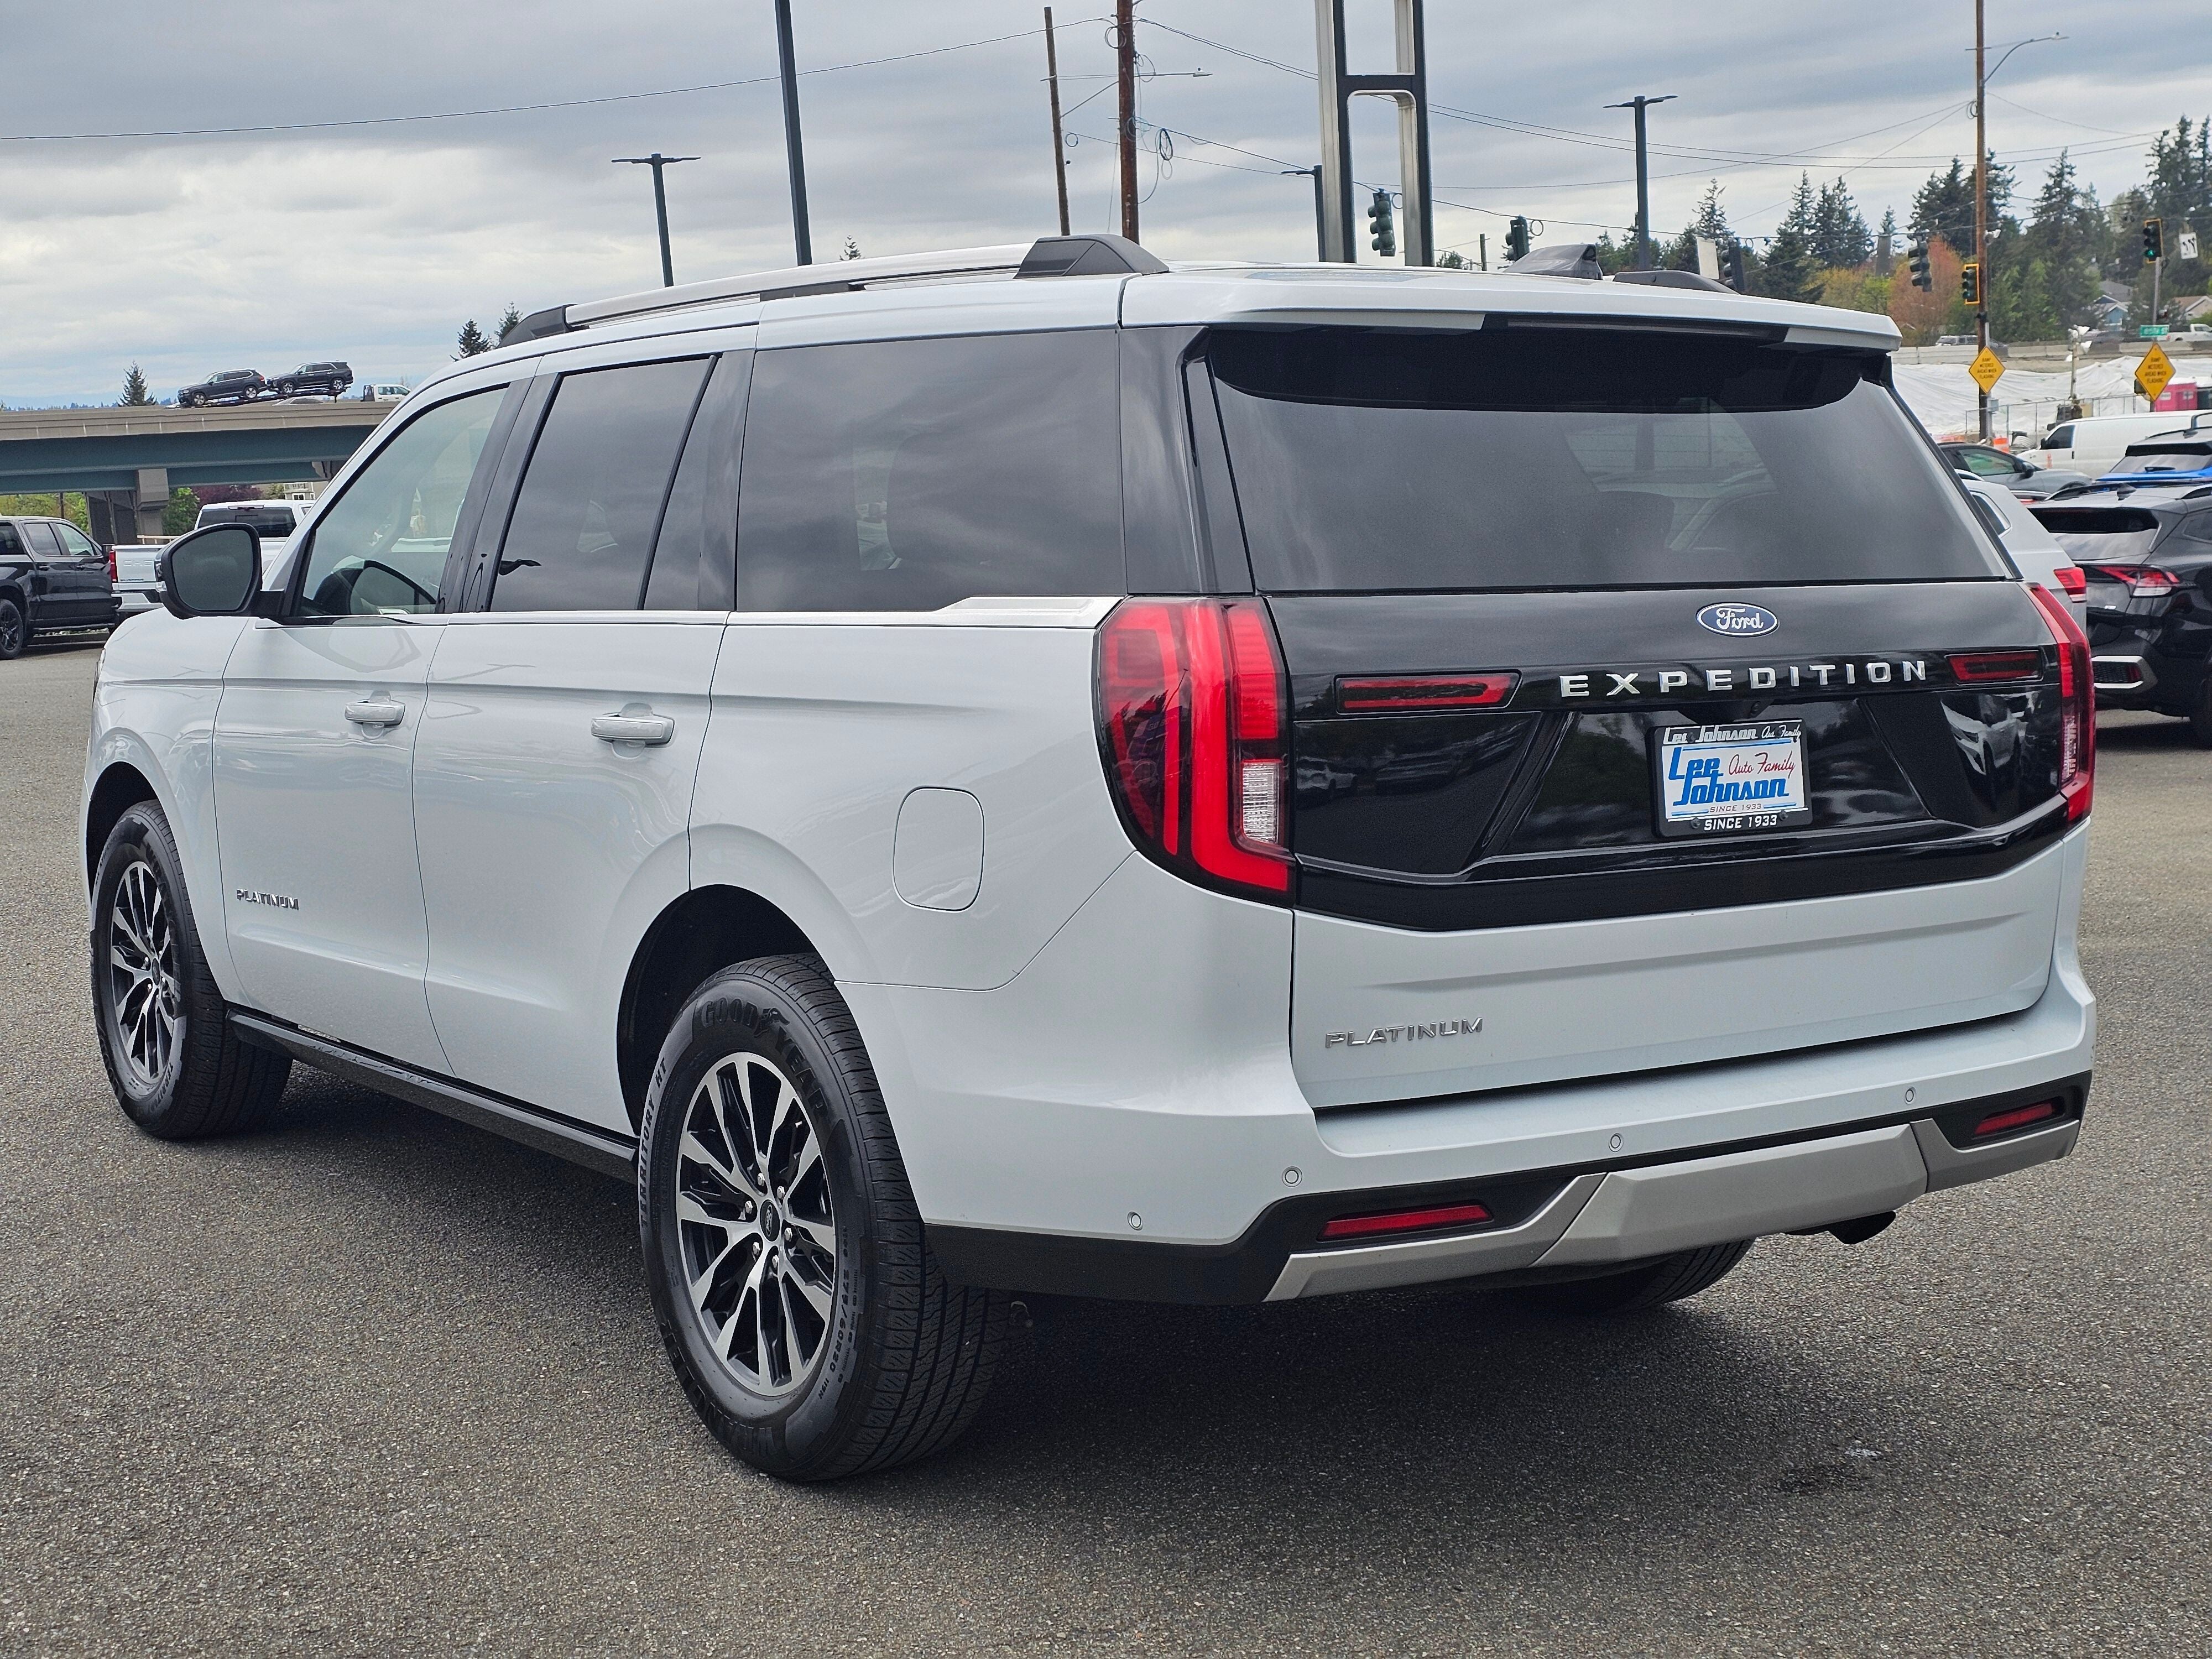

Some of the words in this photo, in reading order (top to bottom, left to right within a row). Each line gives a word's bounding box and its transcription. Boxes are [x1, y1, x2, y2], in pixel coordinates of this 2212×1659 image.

[1716, 608, 1764, 630] Ford
[1559, 660, 1926, 697] EXPEDITION
[1695, 725, 1758, 743] Johnson
[1668, 747, 1724, 780] Lee
[1729, 754, 1754, 775] Auto
[1755, 750, 1796, 779] Family
[1673, 772, 1790, 806] Johnson
[1710, 805, 1737, 813] SINCE
[1704, 817, 1743, 831] SINCE
[1749, 815, 1777, 827] 1933
[236, 889, 299, 910] PLATINUM
[1325, 1017, 1483, 1048] PLATINUM
[640, 1093, 655, 1228] TERRITORY
[655, 1057, 666, 1088] HT
